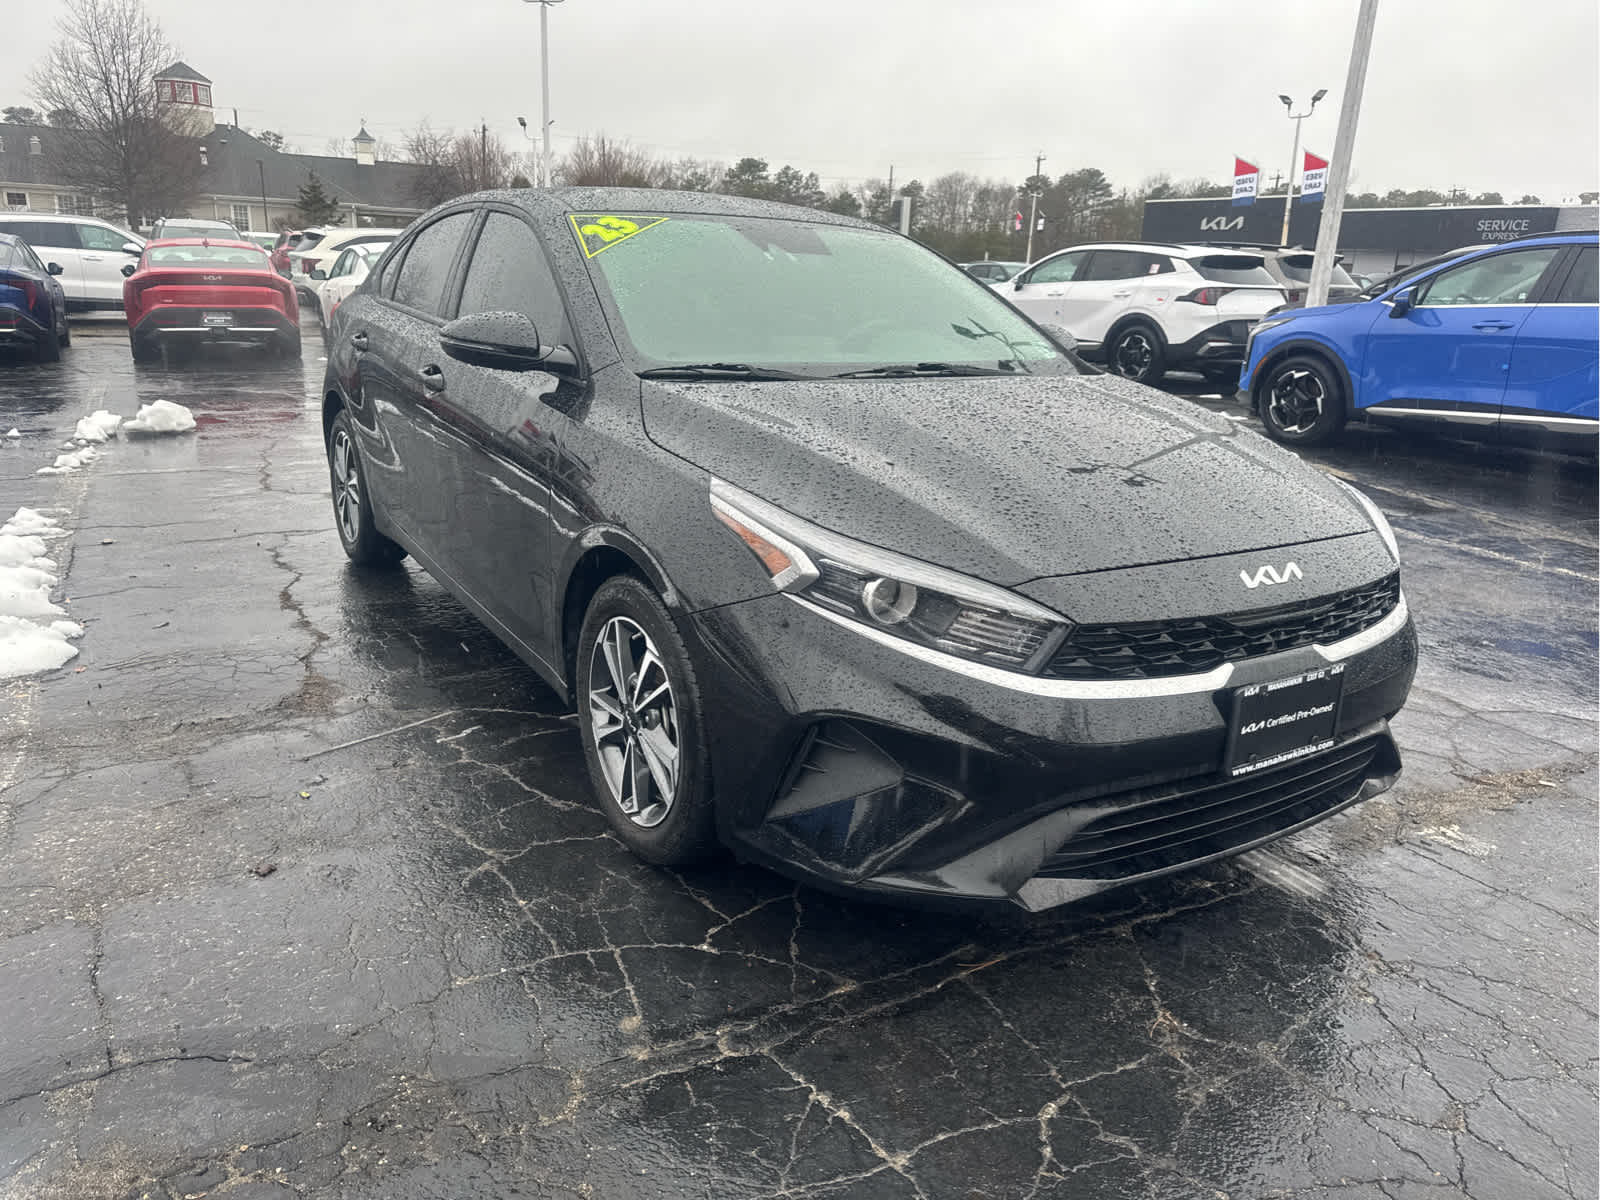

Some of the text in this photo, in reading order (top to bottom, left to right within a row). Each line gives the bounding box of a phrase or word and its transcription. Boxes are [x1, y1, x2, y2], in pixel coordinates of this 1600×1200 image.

[1200, 216, 1245, 230] KIA
[1476, 219, 1531, 232] SERVICE
[1481, 232, 1520, 241] EXPRESS
[1240, 561, 1304, 589] KIA
[1241, 703, 1334, 735] KIA Certified Pre-Owned
[1232, 740, 1335, 777] www.manahawkinkia.com
